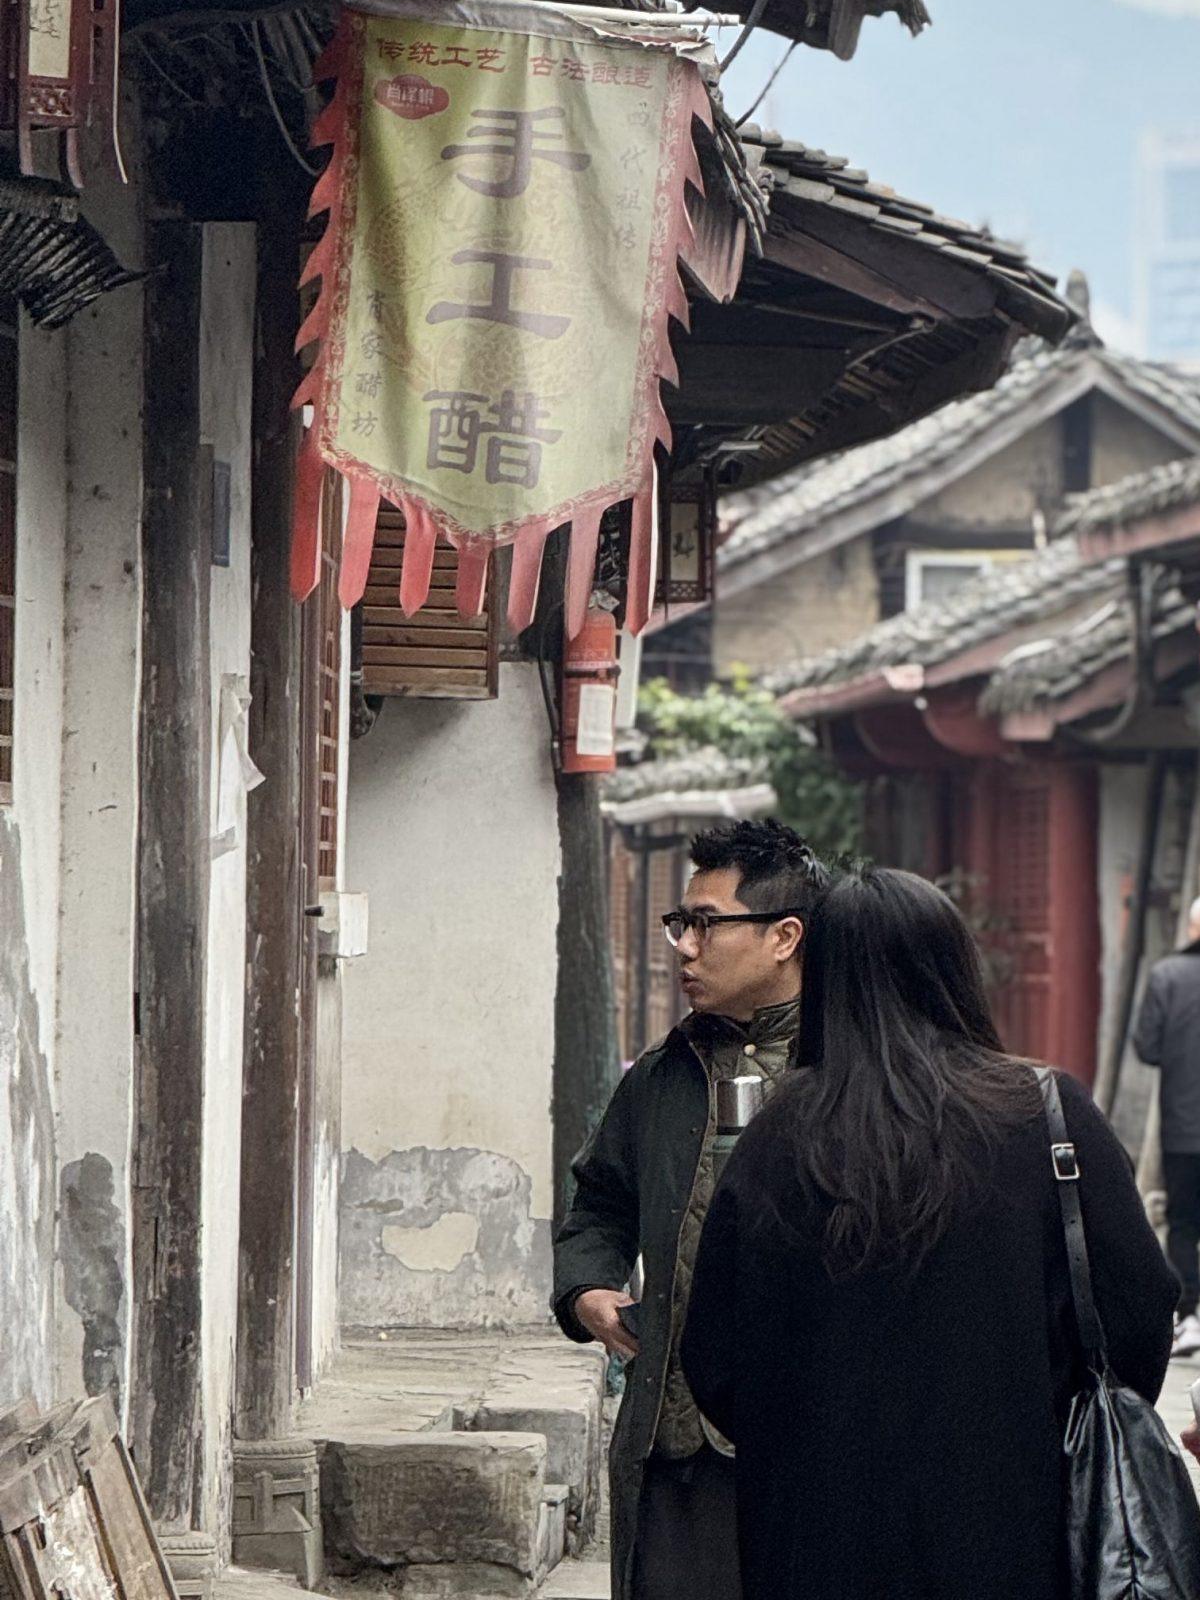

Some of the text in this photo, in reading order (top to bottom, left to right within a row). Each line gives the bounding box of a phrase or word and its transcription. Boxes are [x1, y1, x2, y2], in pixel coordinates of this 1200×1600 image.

[377, 37, 654, 90] 传统工艺 古法酿造
[422, 106, 592, 491] 手工醋
